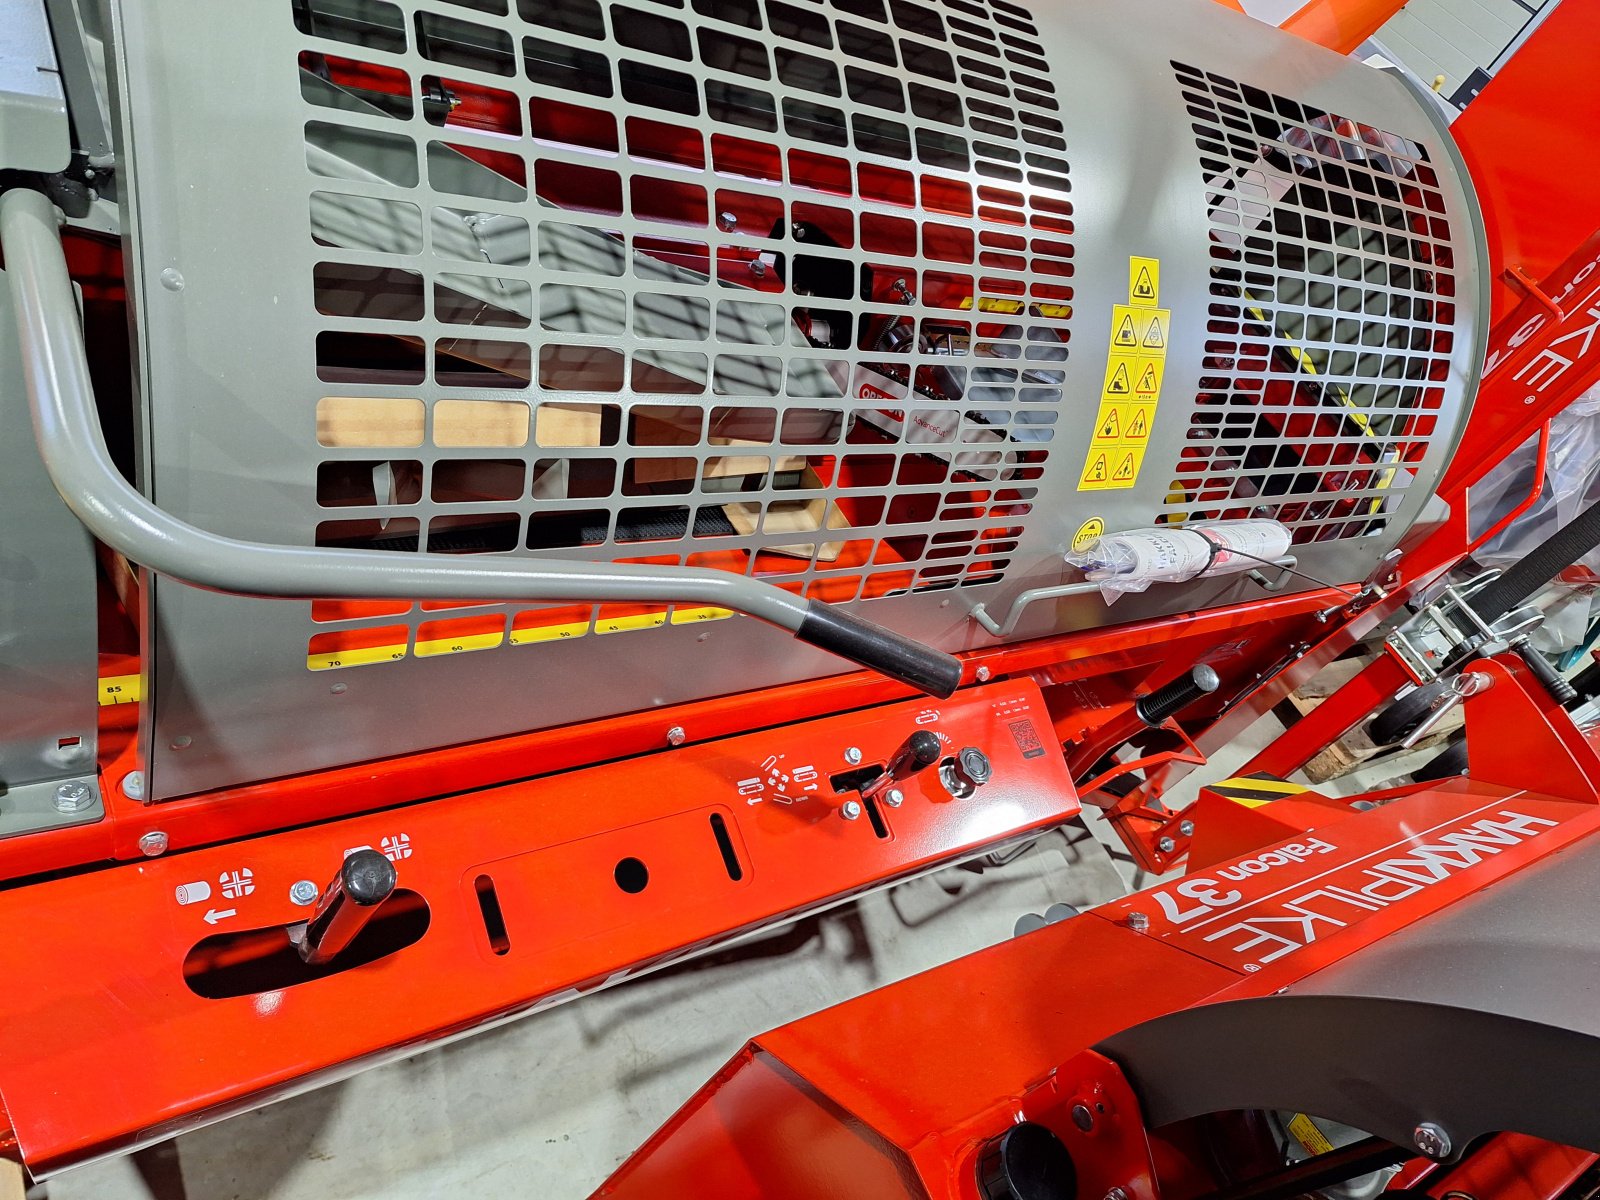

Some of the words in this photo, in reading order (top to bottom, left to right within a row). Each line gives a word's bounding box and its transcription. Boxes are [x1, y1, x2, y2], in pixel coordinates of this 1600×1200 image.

[328, 660, 341, 668] 70
[392, 652, 404, 660] 65
[106, 685, 122, 693] 85
[1216, 837, 1338, 881] Falcon
[1151, 878, 1242, 924] 37
